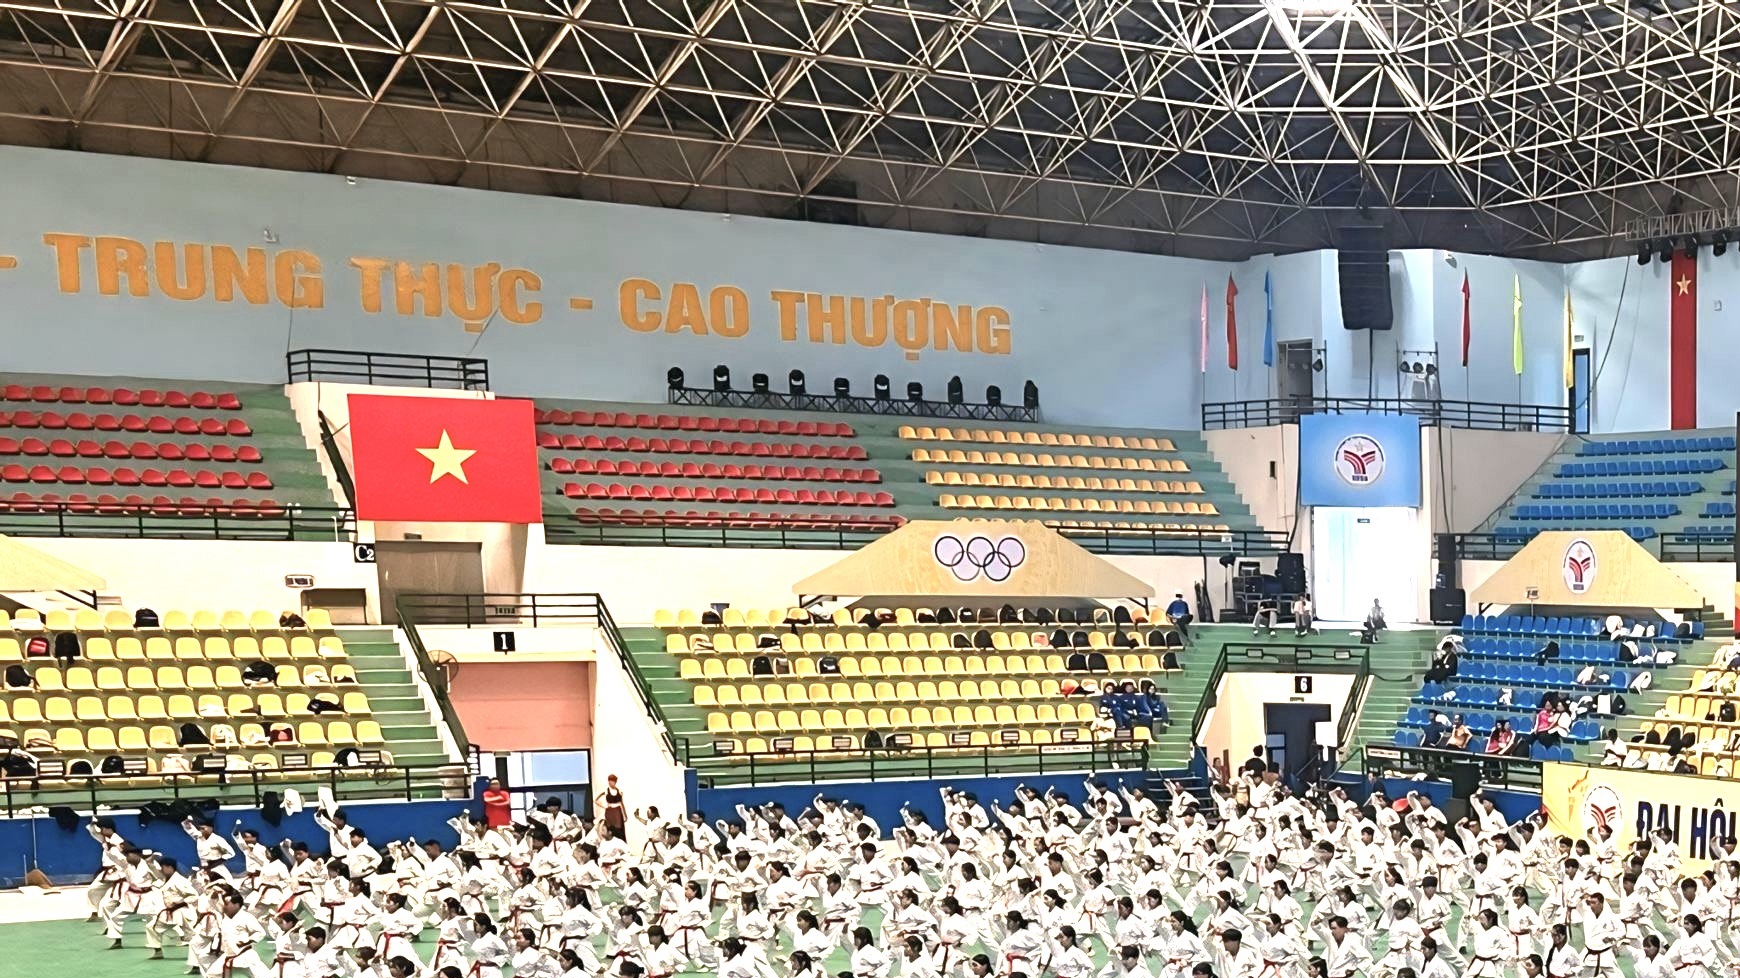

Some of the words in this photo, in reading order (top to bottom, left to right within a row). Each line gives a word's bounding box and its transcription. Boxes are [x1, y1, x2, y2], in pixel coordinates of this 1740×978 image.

[42, 232, 325, 309] TRUNG
[350, 257, 543, 333] THỰC
[619, 277, 750, 338] CAO
[770, 290, 1012, 360] THƯỢNG
[355, 544, 375, 562] C2
[500, 633, 509, 650] 1
